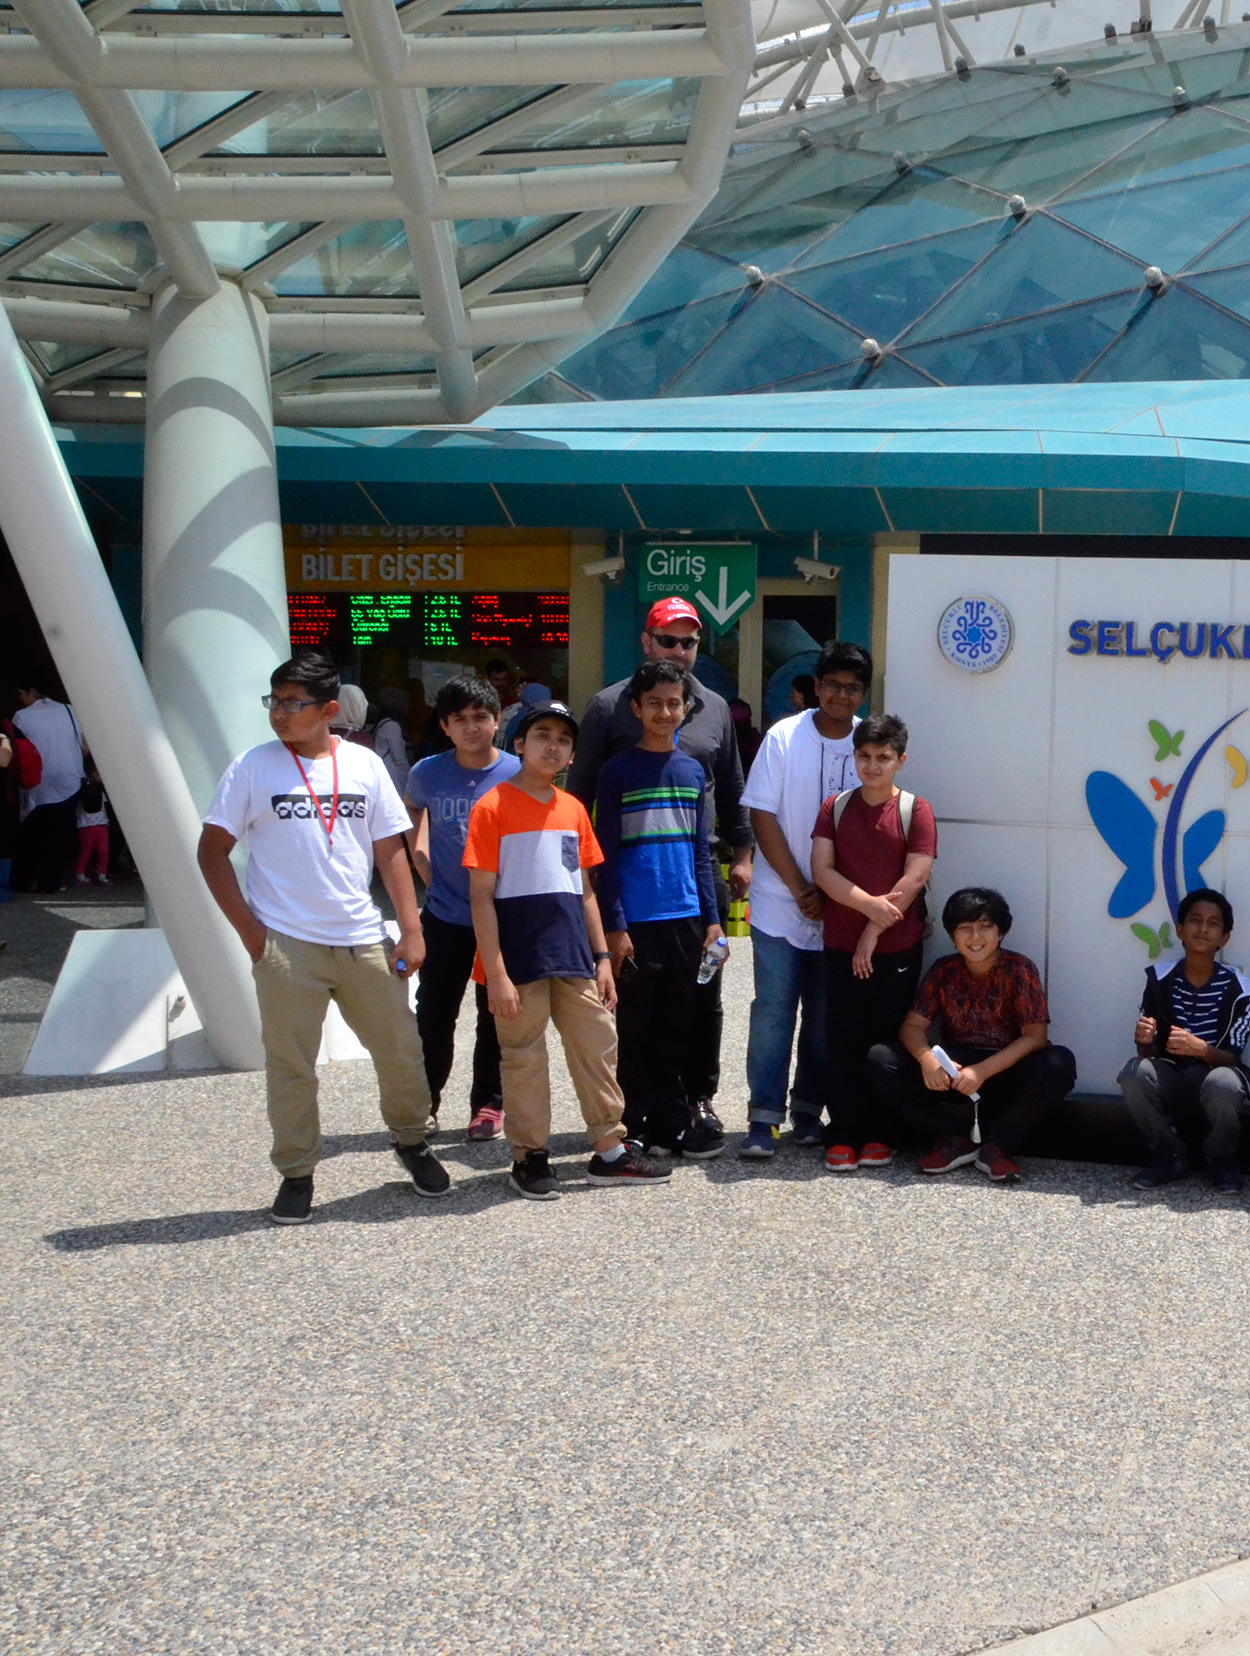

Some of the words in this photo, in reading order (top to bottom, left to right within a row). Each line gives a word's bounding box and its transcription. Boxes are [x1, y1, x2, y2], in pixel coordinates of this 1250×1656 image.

[302, 546, 373, 580] BİLET
[378, 546, 464, 587] GİŞESİ
[646, 549, 706, 582] Giriş
[647, 582, 690, 592] Entrance
[950, 652, 977, 668] KONYA
[273, 796, 367, 819] adidas
